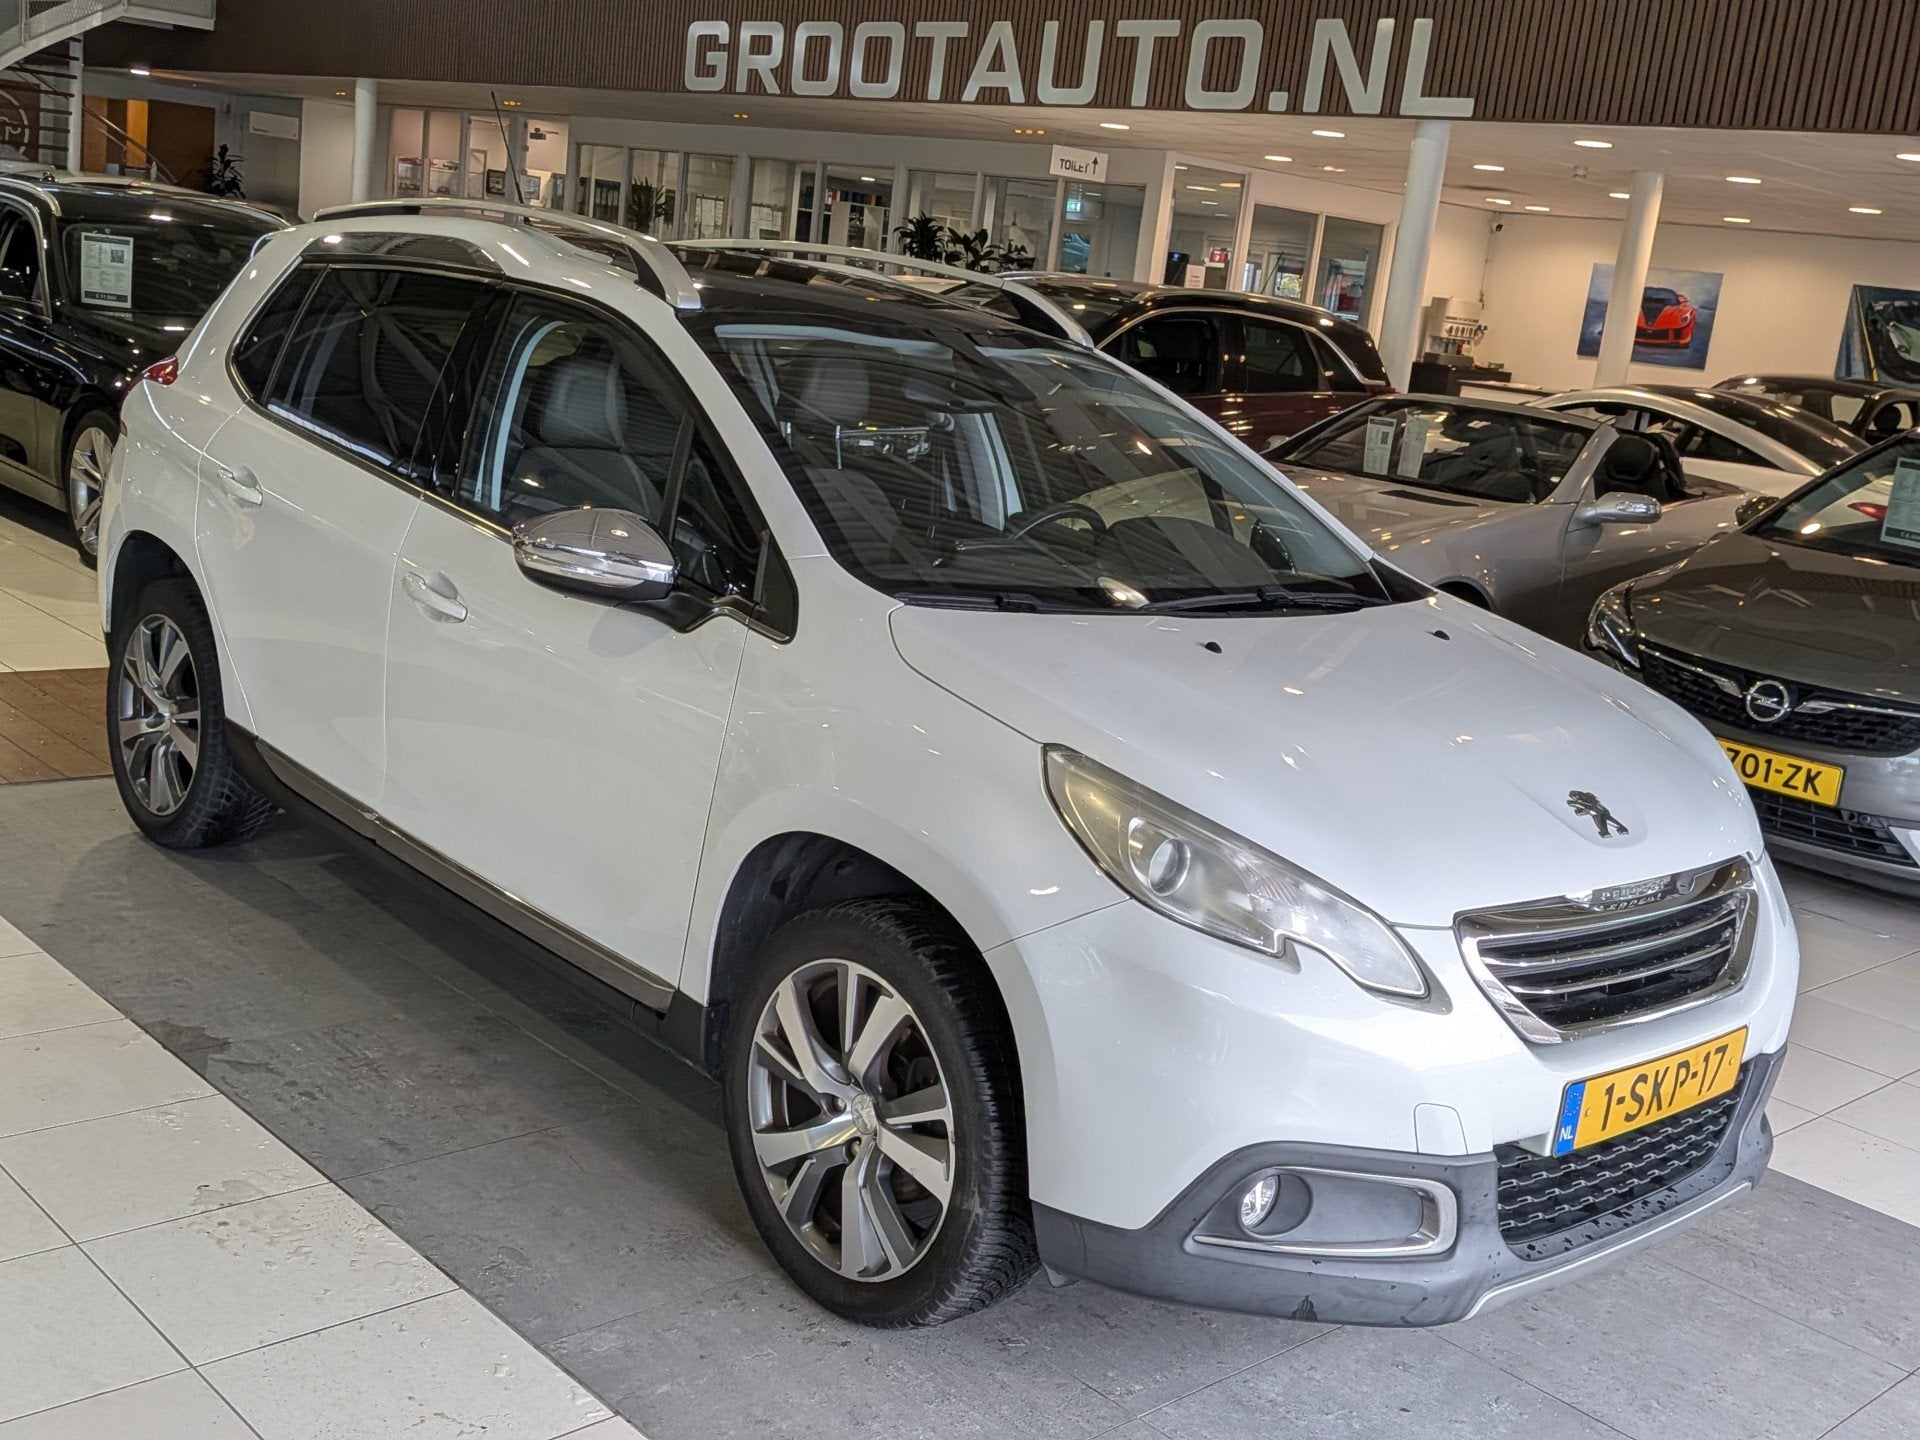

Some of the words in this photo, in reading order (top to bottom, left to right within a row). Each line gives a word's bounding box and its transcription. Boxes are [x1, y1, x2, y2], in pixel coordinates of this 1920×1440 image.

[684, 18, 1475, 118] GROOTAUTO.NL
[1059, 158, 1090, 174] TOILET
[1601, 1043, 1730, 1133] 1-SKP-17
[1558, 1125, 1574, 1142] NL
